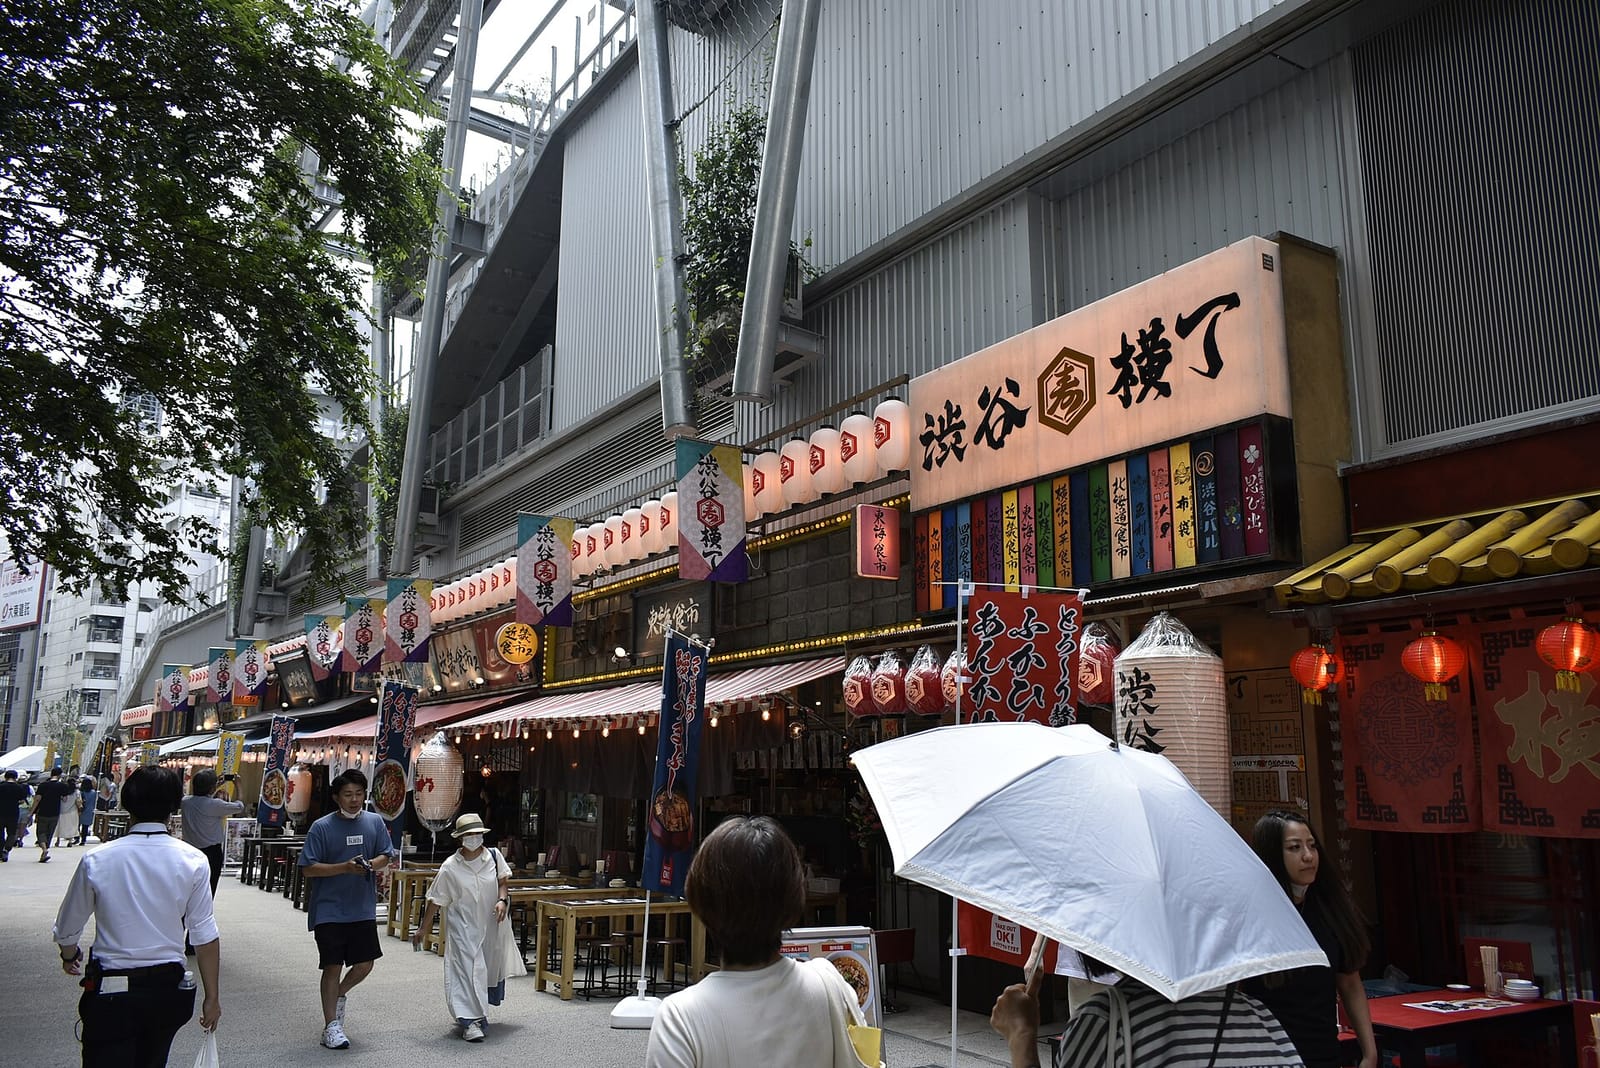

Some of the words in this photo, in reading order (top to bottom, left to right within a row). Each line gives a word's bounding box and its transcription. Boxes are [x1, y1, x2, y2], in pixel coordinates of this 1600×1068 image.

[873, 509, 887, 575] 東海食市
[1112, 477, 1129, 561] 北海道食市
[1201, 483, 1218, 549] 渋谷バル
[1119, 667, 1168, 754] 渋谷
[997, 929, 1014, 945] OK!
